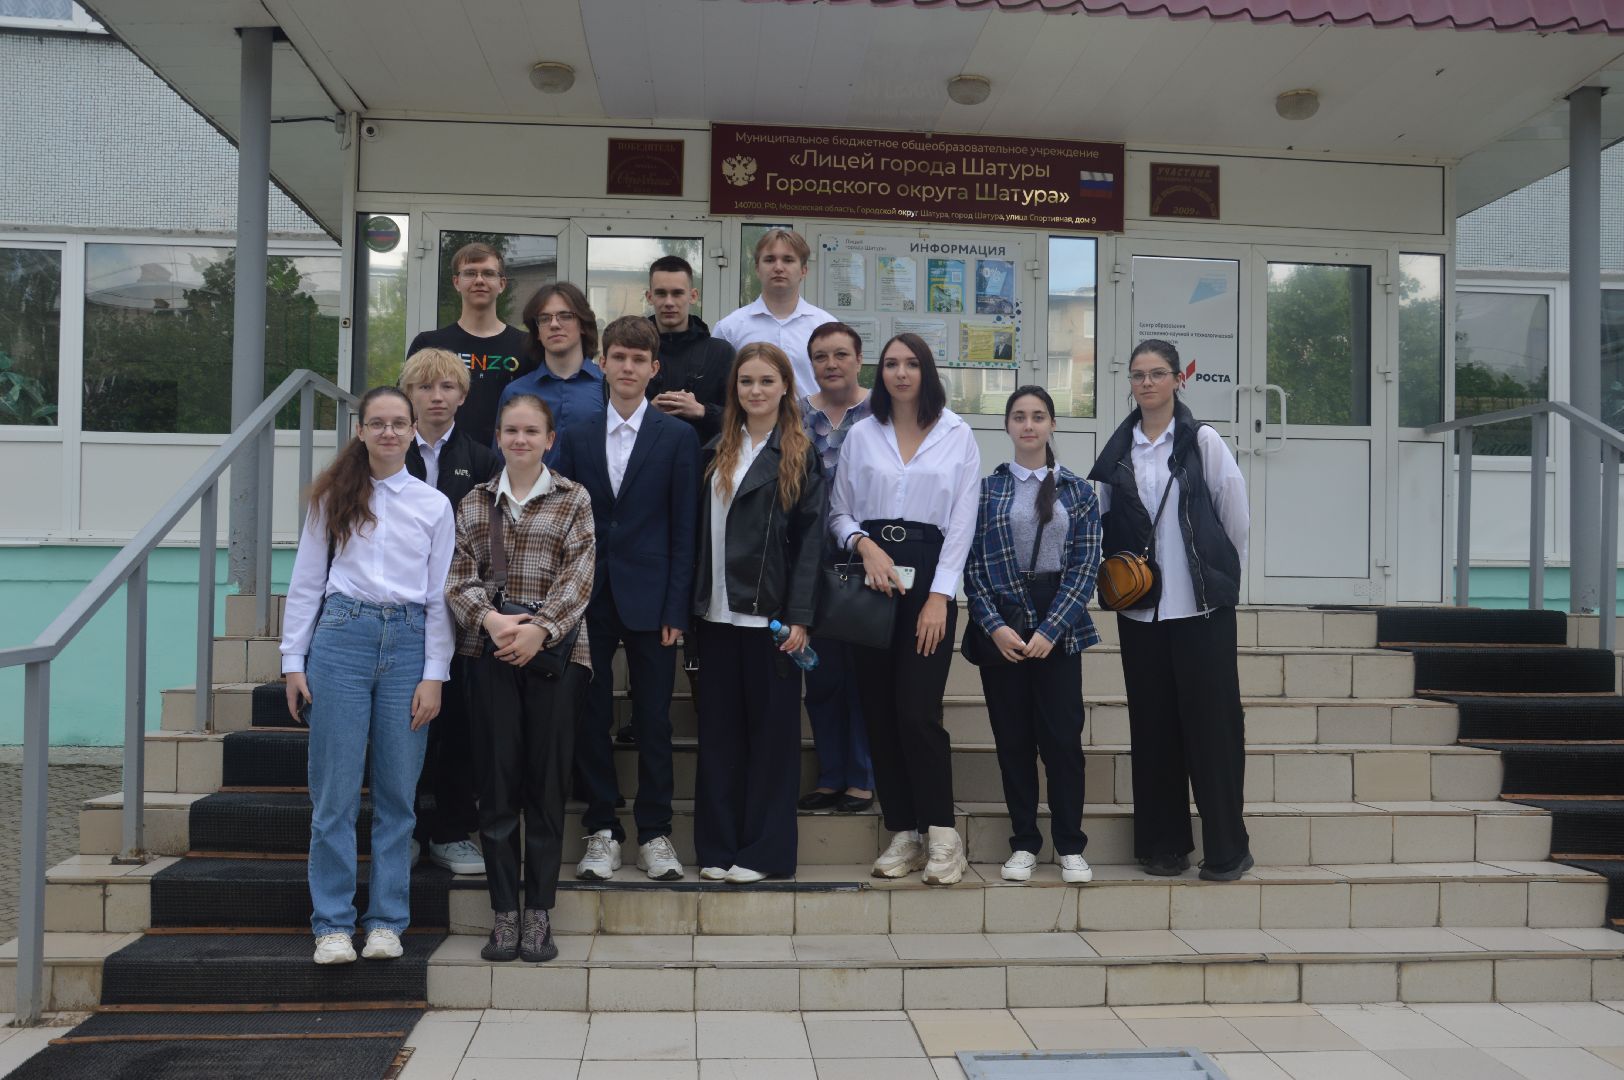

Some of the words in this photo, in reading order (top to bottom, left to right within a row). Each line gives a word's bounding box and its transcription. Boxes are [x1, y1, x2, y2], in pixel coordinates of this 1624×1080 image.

[735, 132, 829, 145] Муниципальное
[832, 136, 899, 149] бюджетное
[902, 140, 1028, 155] общеобразовательное
[1030, 147, 1099, 159] учреждение
[790, 150, 874, 171] «Лицей
[881, 158, 956, 177] города
[962, 157, 1050, 180] Шатуры
[766, 173, 890, 196] Городского
[897, 184, 968, 202] округа
[975, 183, 1070, 206] Шатура»
[780, 203, 823, 212] Московская
[857, 206, 897, 216] Городской
[898, 209, 918, 218] округ
[951, 212, 973, 220] город
[1006, 214, 1028, 222] улица
[1029, 214, 1073, 224] Спортивная,
[1091, 216, 1097, 224] 9
[910, 243, 1006, 257] ИНФОРМАЦИЯ
[457, 353, 520, 372] ENZO
[1195, 373, 1231, 383] РОСТА
